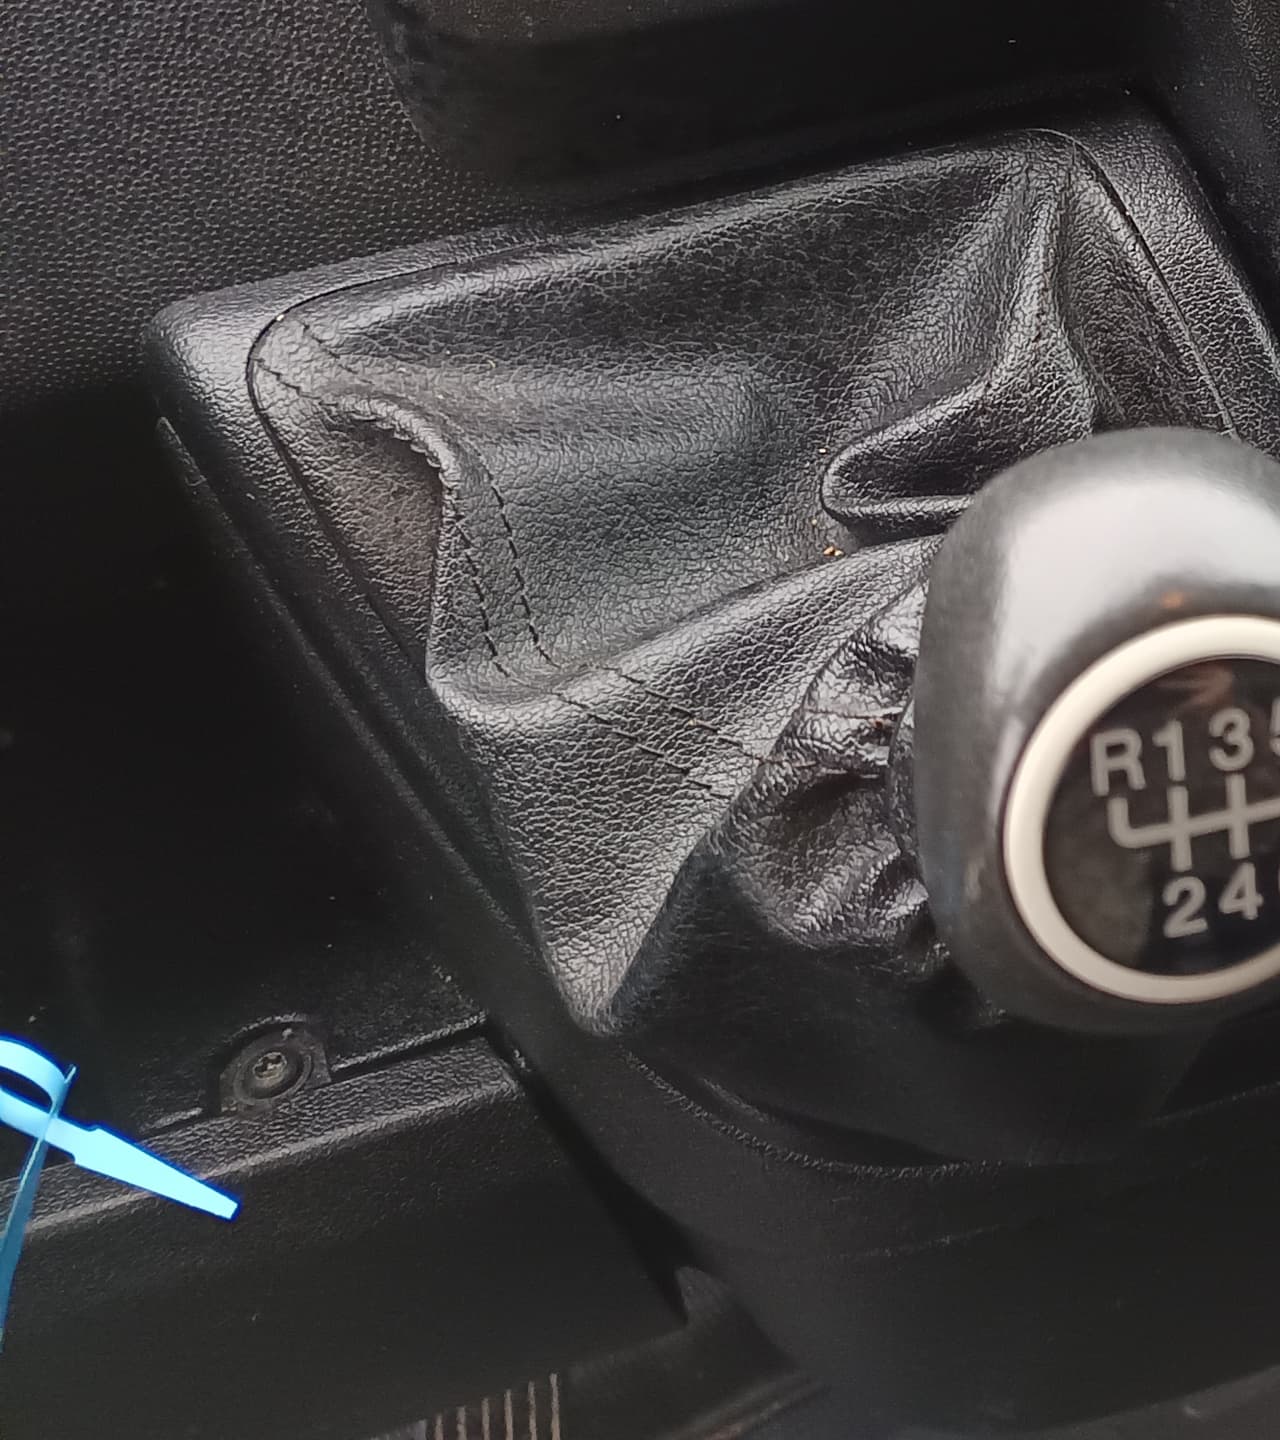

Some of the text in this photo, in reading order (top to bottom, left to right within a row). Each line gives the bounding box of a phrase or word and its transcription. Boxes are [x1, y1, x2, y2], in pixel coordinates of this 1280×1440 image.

[1089, 727, 1146, 797] R
[1151, 719, 1186, 782] 1
[1207, 707, 1255, 772] 3
[1161, 876, 1209, 939] 2
[1217, 861, 1264, 921] 4
